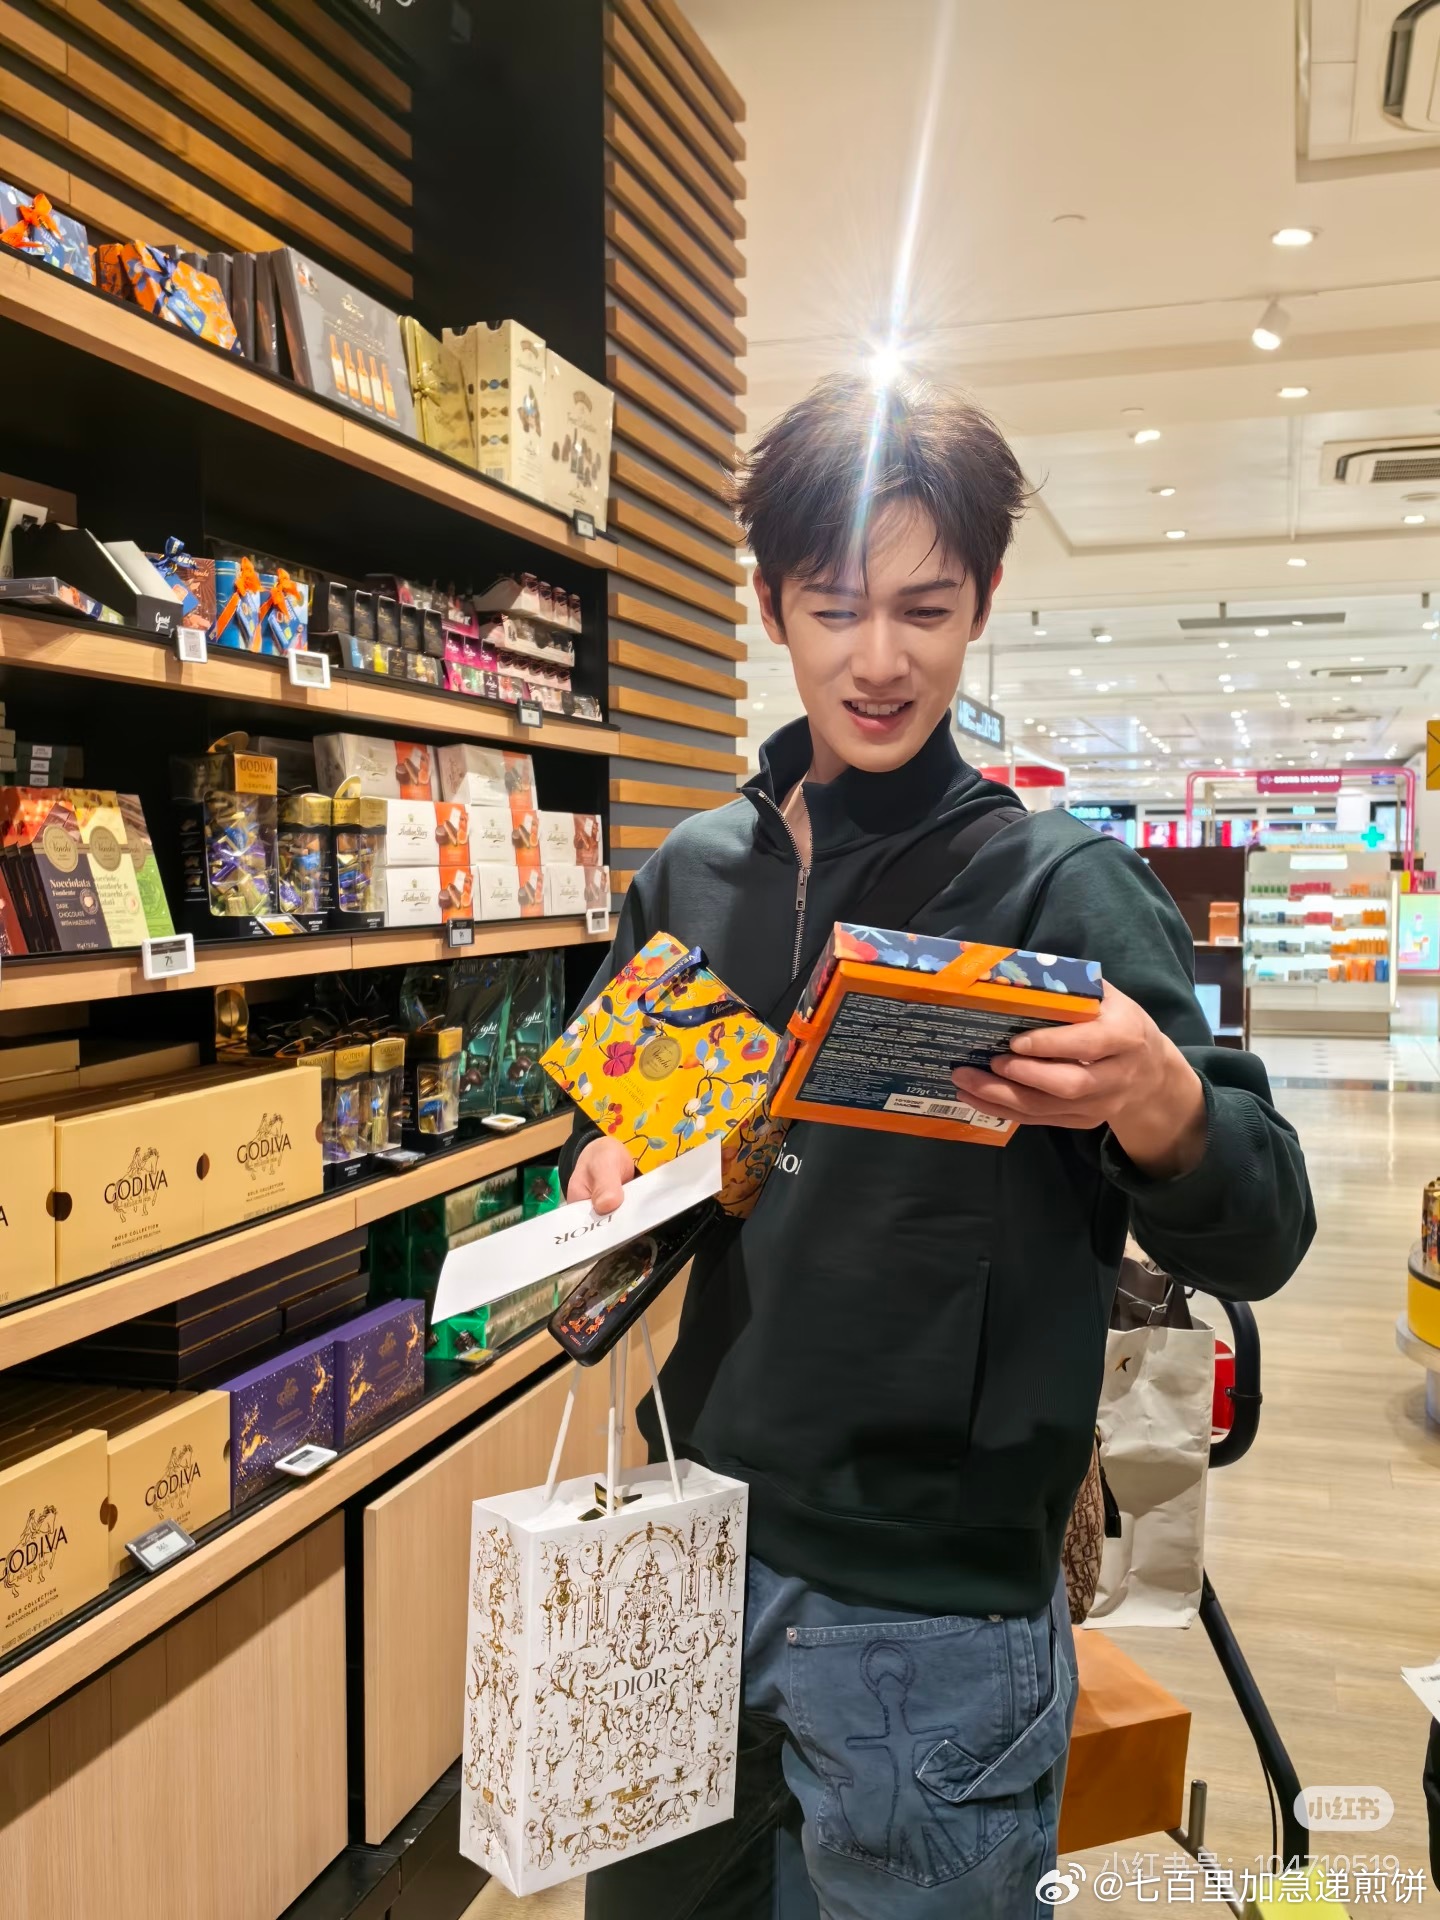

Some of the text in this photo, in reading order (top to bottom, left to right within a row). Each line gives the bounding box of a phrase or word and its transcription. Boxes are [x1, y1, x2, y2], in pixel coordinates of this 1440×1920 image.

[240, 759, 274, 773] GODIVA
[236, 1133, 292, 1164] GODIVA
[104, 1169, 168, 1204] GODIVA
[145, 1462, 201, 1507] GODIVA
[0, 1525, 68, 1582] GODIVA
[23, 1588, 57, 1611] COLLECTION
[612, 1667, 670, 1701] DIOR
